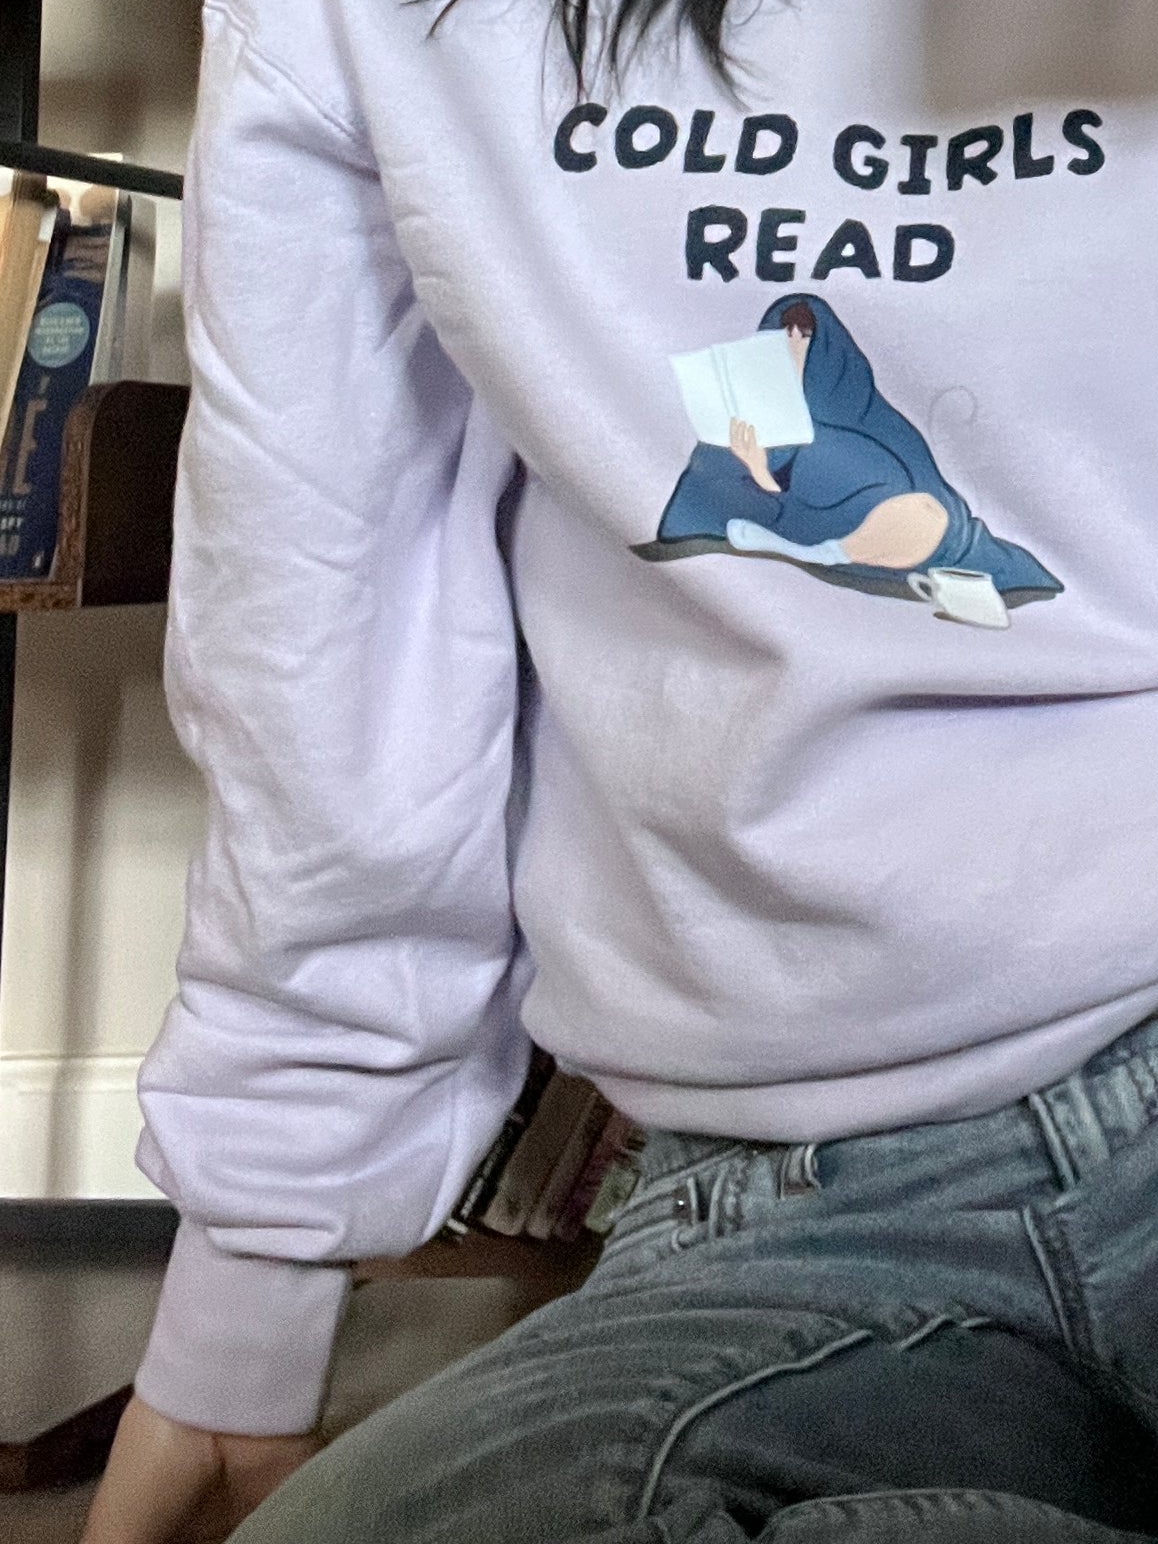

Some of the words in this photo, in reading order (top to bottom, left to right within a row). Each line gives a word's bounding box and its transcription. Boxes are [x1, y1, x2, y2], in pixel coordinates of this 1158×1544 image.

[553, 103, 798, 175] COLD
[832, 109, 1106, 196] GIRLS
[685, 204, 956, 283] READ
